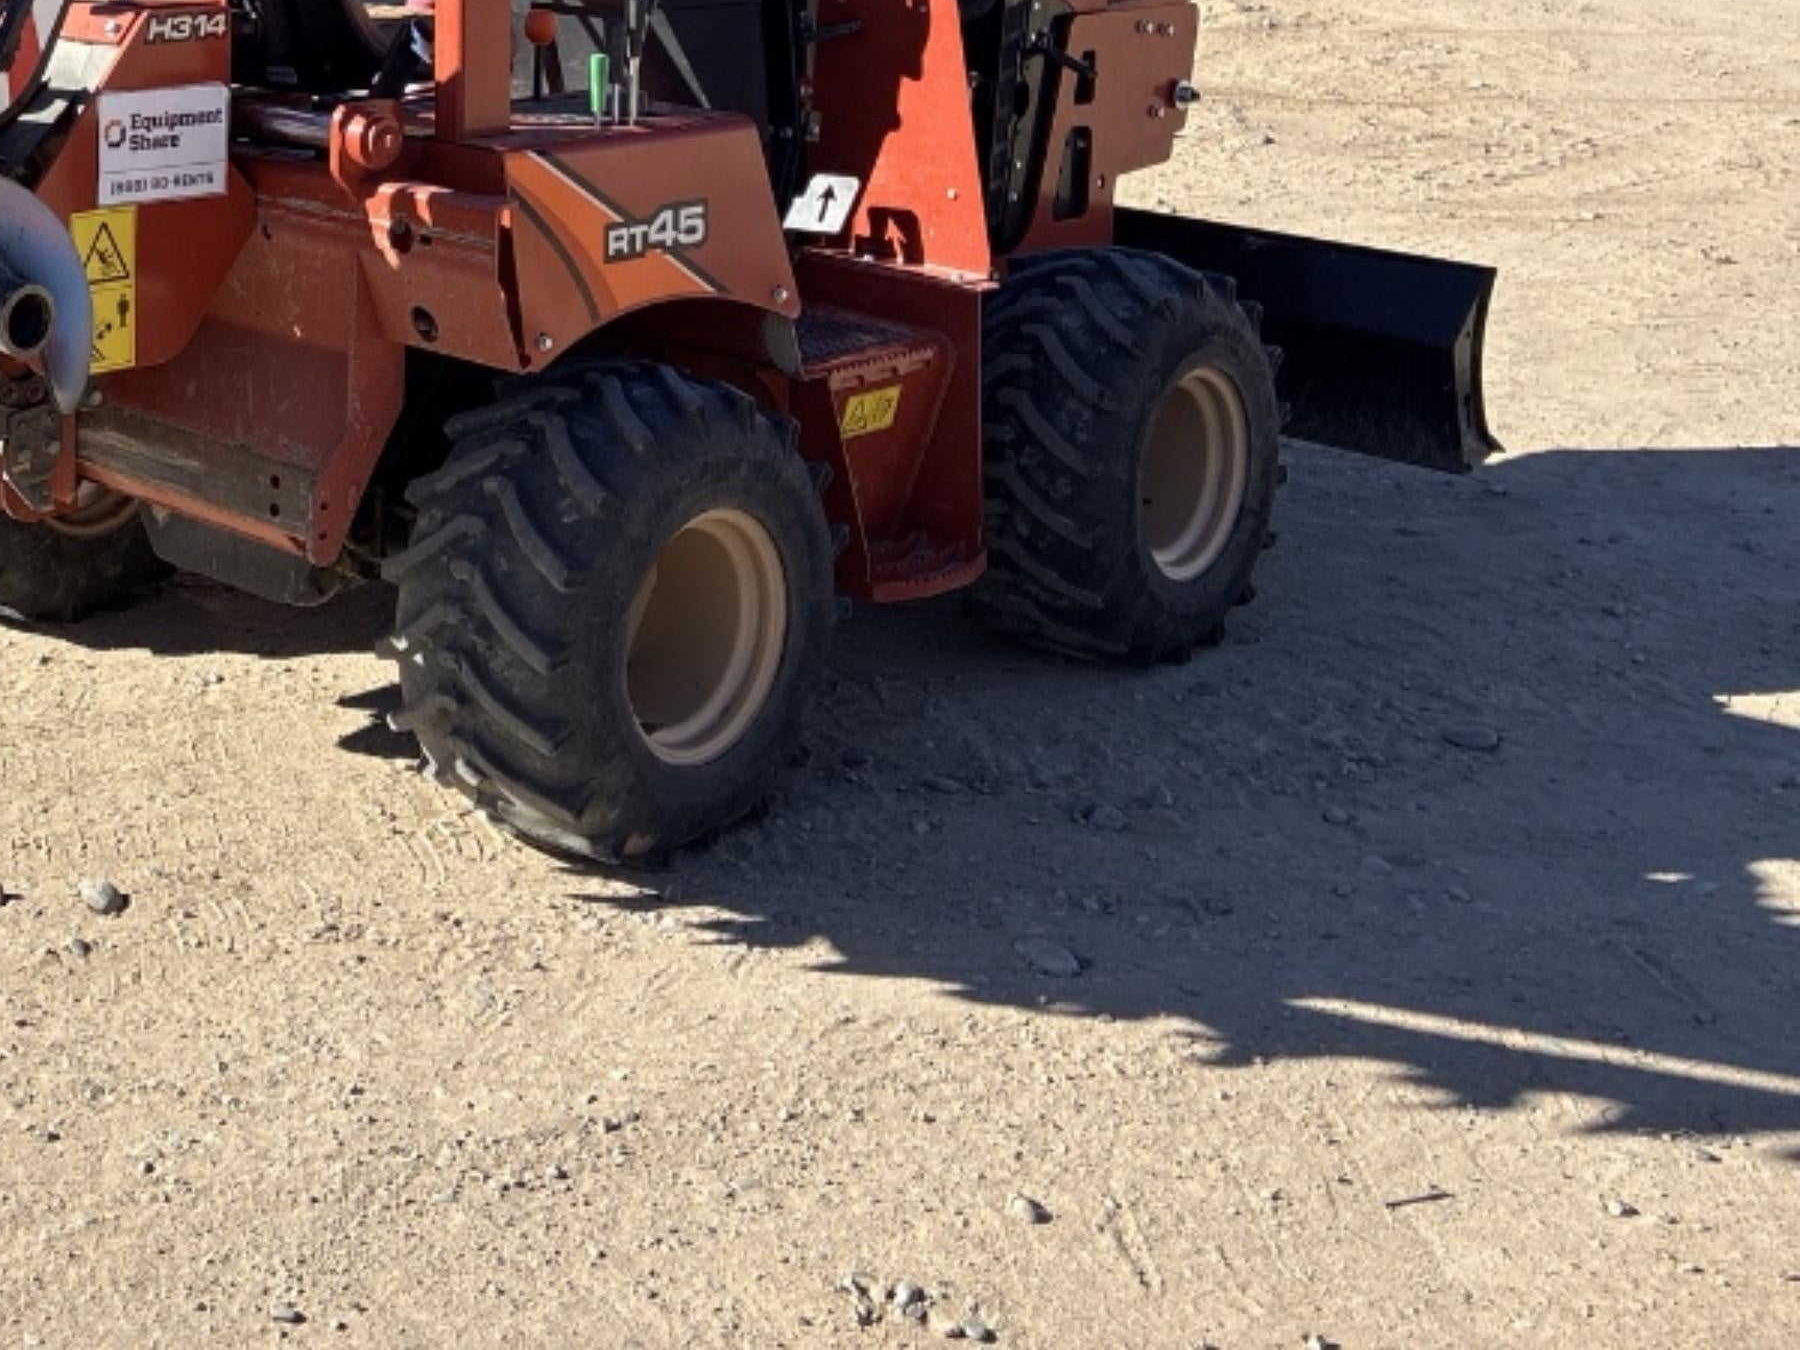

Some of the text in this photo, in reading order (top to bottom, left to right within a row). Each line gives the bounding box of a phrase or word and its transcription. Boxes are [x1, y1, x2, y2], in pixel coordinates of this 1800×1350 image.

[147, 14, 226, 41] H314
[128, 107, 223, 132] Equipment
[128, 134, 180, 151] Share
[608, 206, 706, 256] RT45
